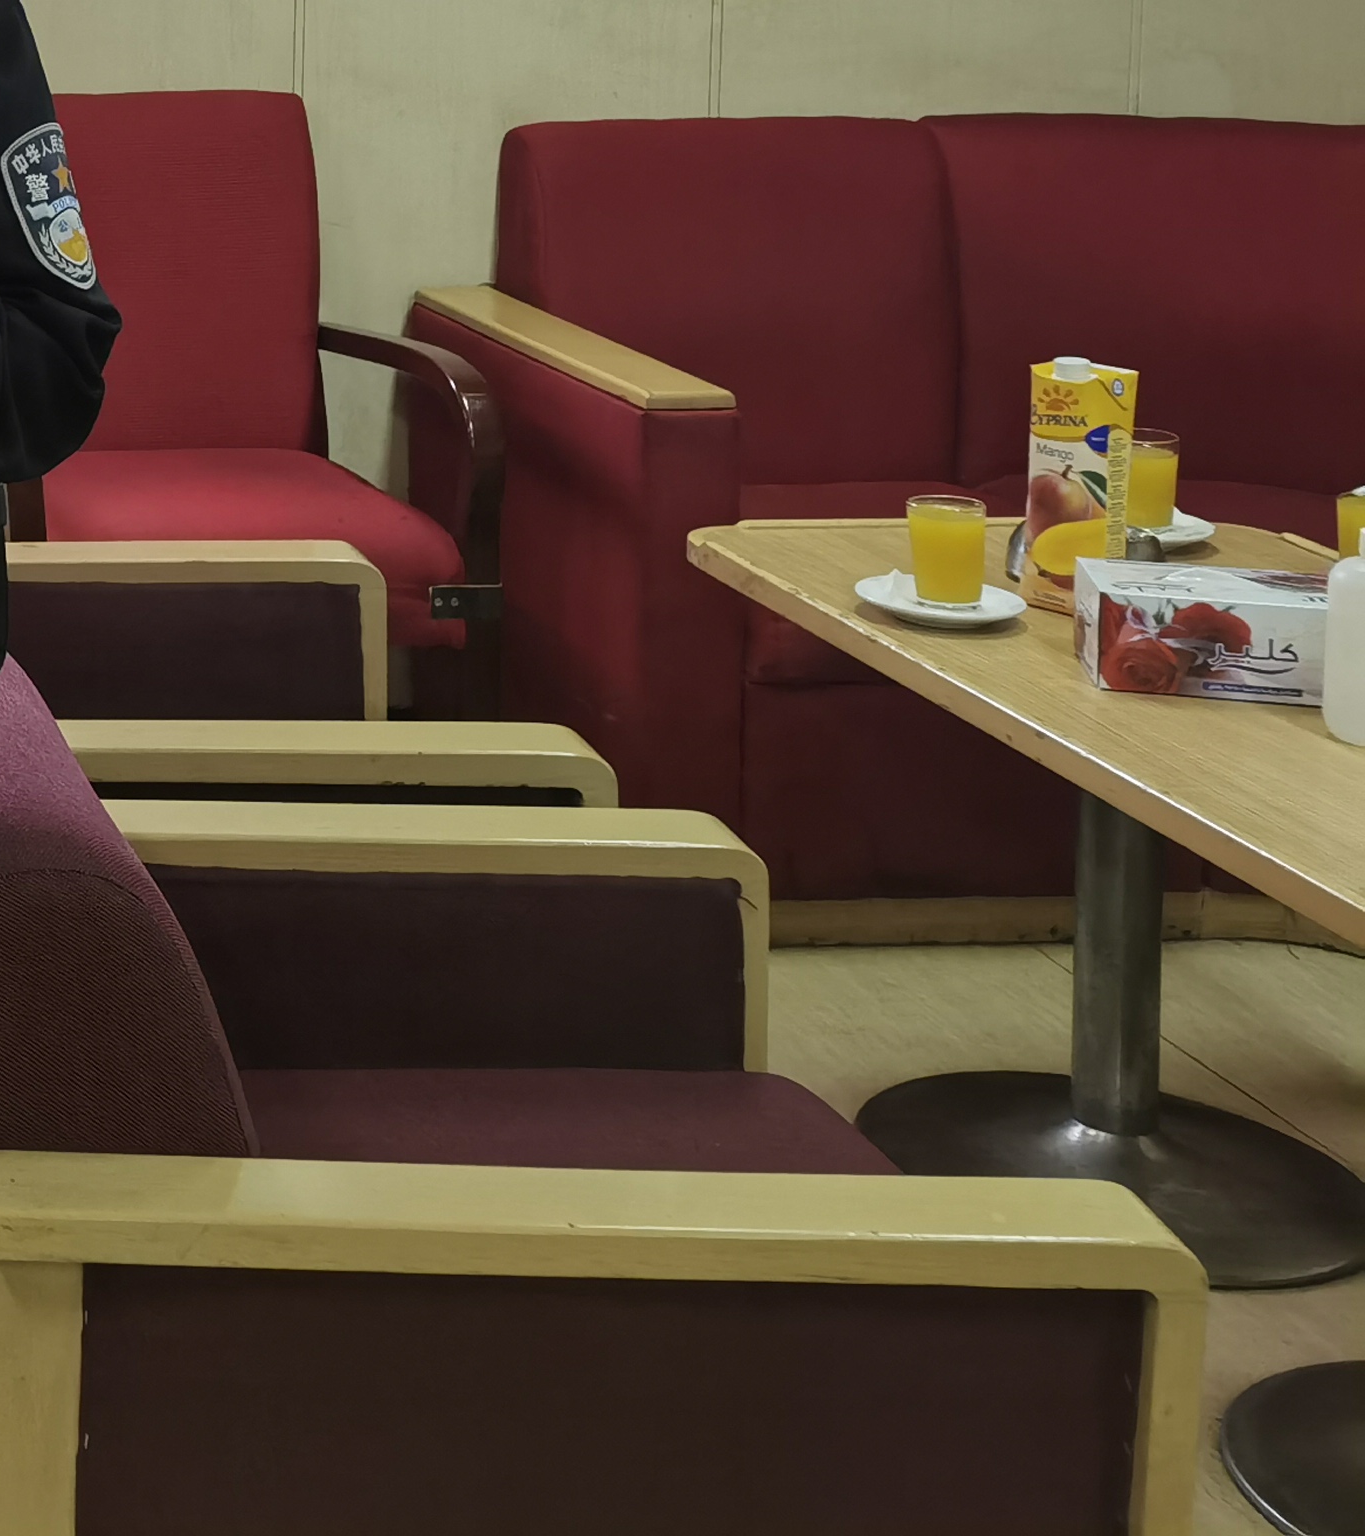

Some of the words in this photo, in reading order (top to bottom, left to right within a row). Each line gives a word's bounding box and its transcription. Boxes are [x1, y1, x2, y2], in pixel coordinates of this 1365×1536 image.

[11, 133, 66, 175] 中华人民
[25, 172, 50, 202] 警
[1036, 442, 1074, 464] Mango
